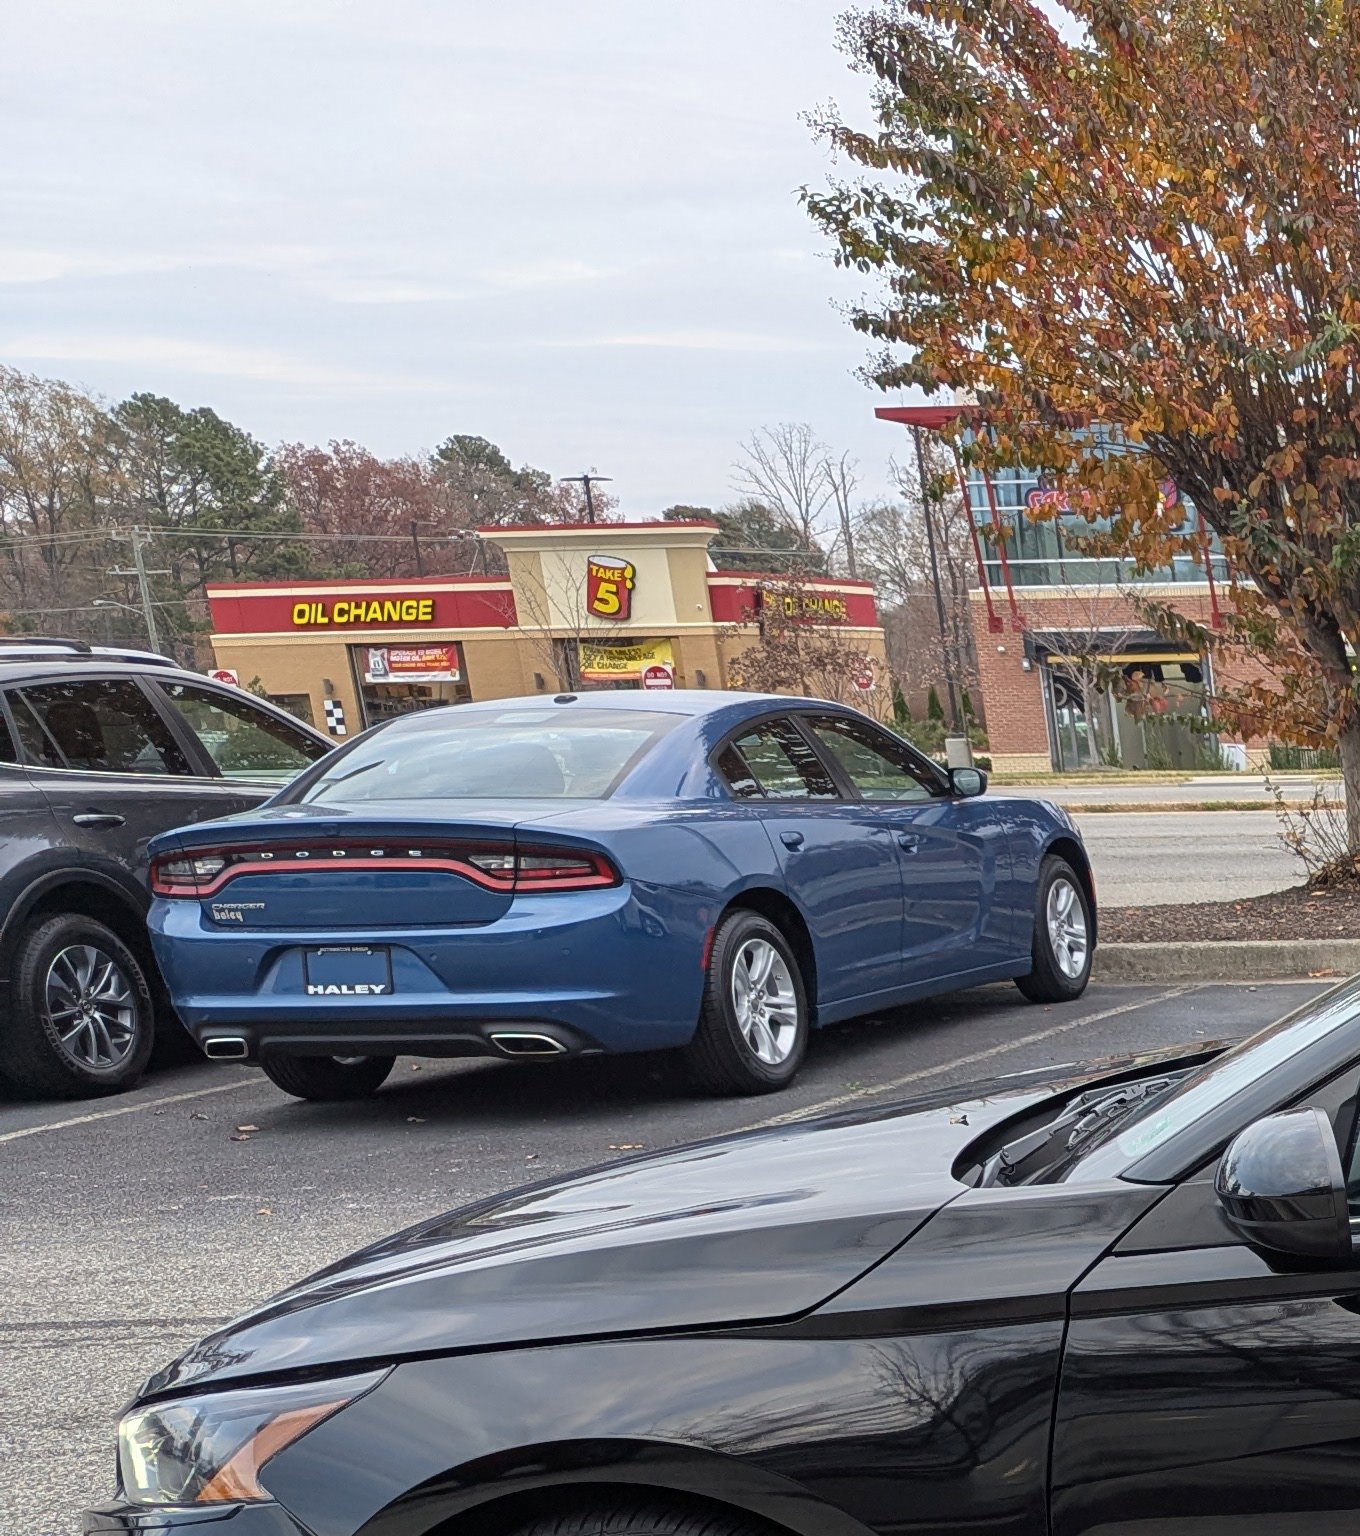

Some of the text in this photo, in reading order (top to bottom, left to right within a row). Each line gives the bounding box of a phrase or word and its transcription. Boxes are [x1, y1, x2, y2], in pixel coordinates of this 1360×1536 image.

[590, 564, 622, 580] TAKE
[592, 583, 621, 615] 5
[292, 599, 434, 625] OIL CHANGE
[260, 850, 422, 858] DODGE
[211, 902, 265, 910] CHARGER
[212, 909, 243, 922] haley
[307, 984, 386, 995] HALEY
